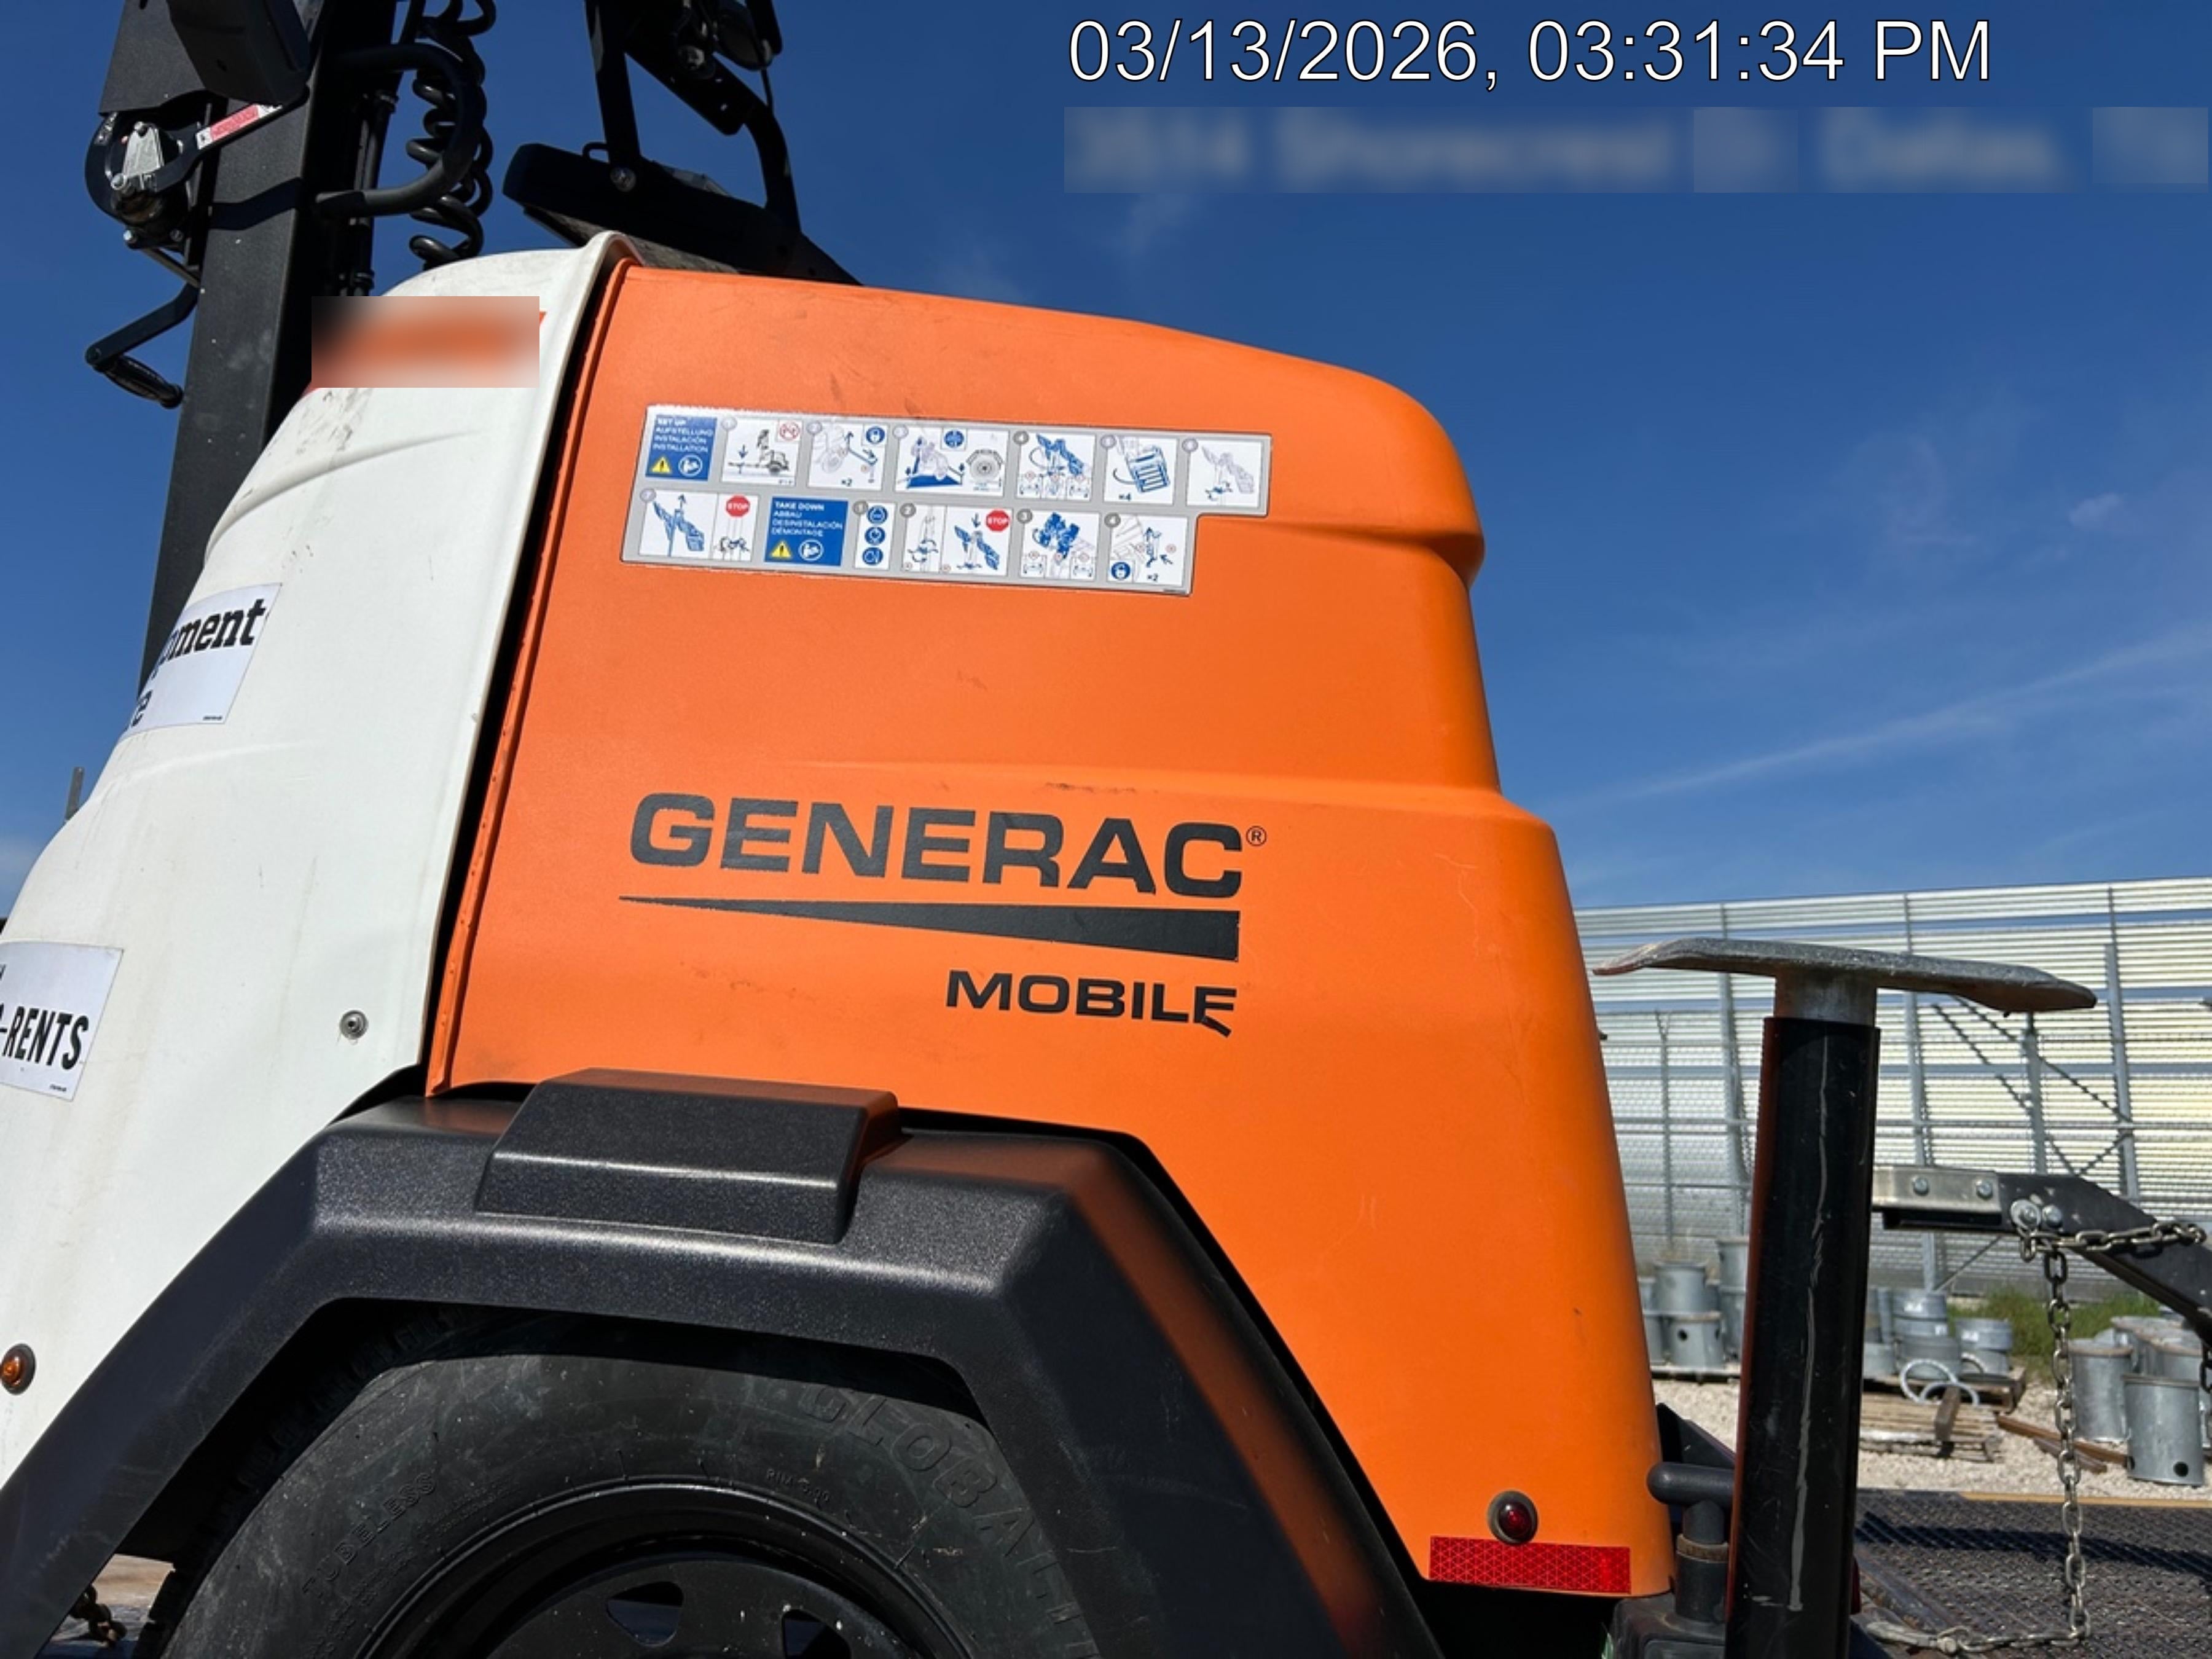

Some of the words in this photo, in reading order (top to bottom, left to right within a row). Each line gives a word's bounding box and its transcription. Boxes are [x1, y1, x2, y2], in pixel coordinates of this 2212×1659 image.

[652, 443, 708, 453] INSTALLATION
[727, 501, 749, 512] STOP
[775, 501, 797, 509] TAKE
[798, 502, 825, 512] DOWN
[772, 510, 802, 519] ABBAU
[987, 516, 1011, 525] STOP
[946, 969, 1237, 1038] MOBILE
